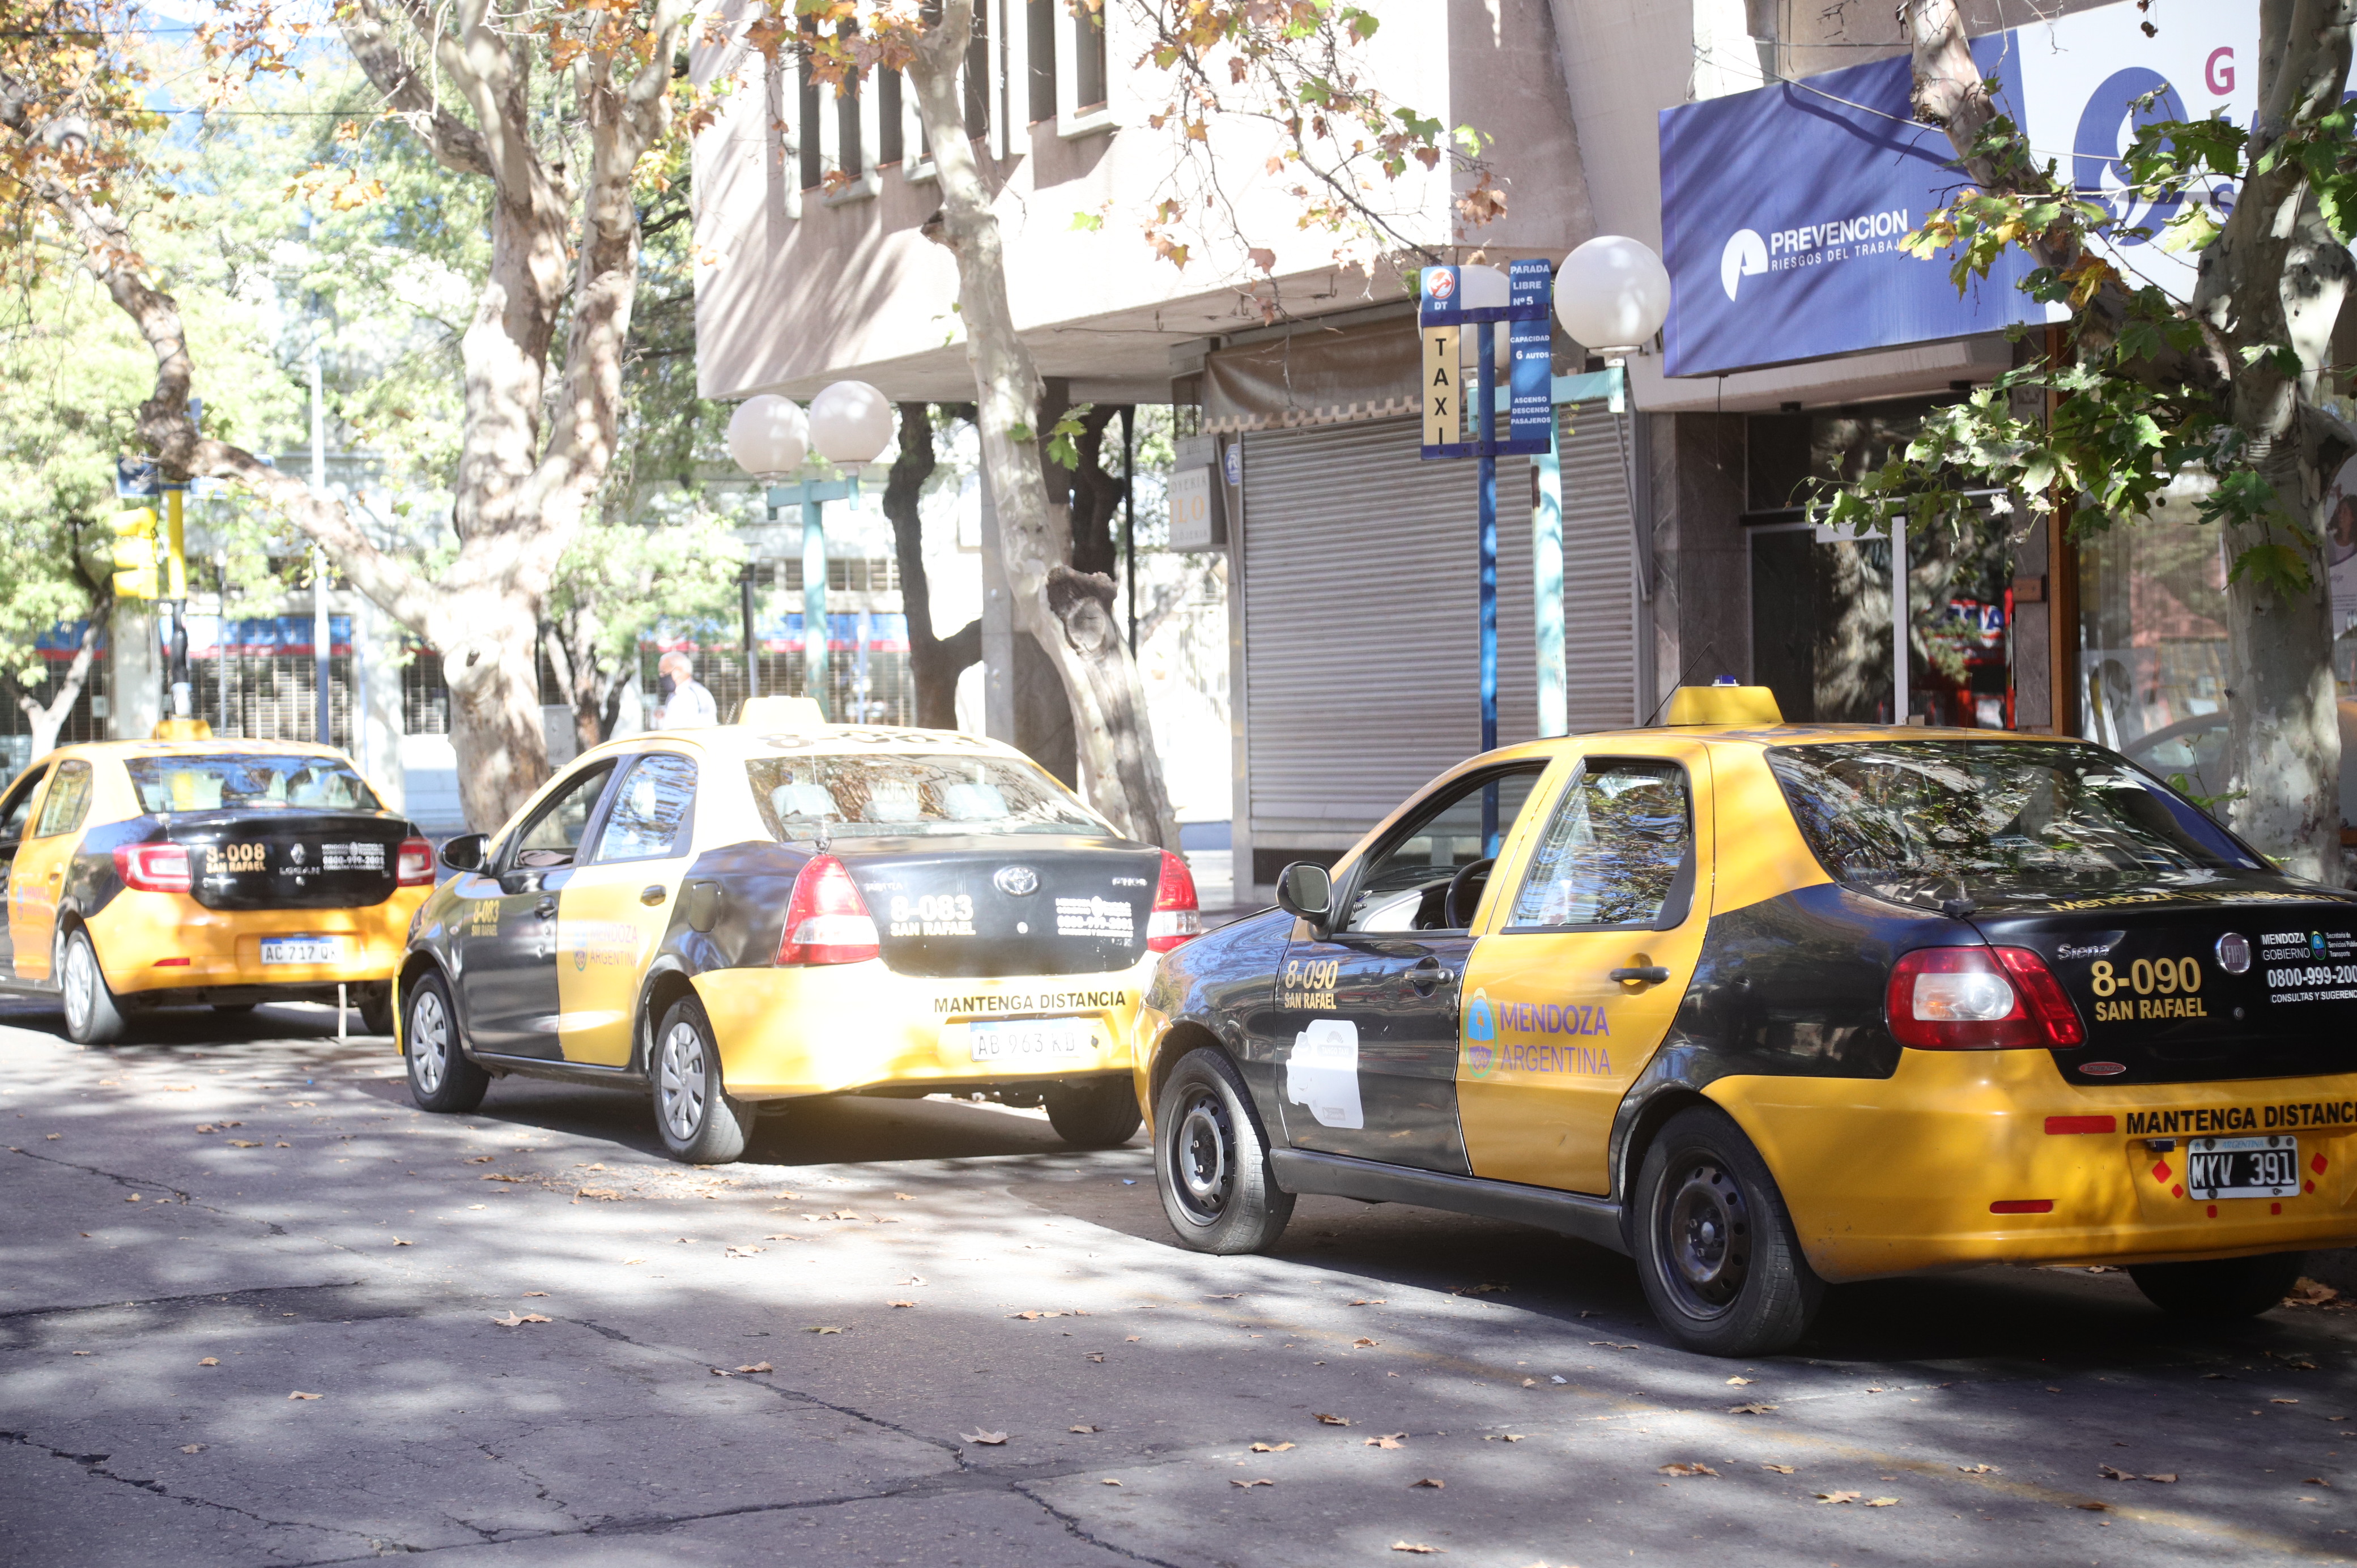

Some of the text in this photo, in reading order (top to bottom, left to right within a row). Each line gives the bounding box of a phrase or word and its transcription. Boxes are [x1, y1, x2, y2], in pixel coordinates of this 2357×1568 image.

[1771, 208, 1908, 255] PREVENCION
[1772, 252, 1822, 271] RIESGOS
[1827, 248, 1849, 262] DEL
[1510, 265, 1550, 274] PARADA
[1513, 281, 1542, 290] LIBRE
[1434, 301, 1448, 310] DT
[1526, 296, 1534, 305] 5
[1510, 335, 1550, 343] CAPACIDAD
[1516, 350, 1523, 360] 6
[1433, 338, 1449, 445] TAXI
[1511, 416, 1551, 425] PASAJEROS
[206, 861, 266, 874] SAN RAFAEL
[322, 855, 385, 864] 0800-999-2001
[473, 900, 500, 923] 8-083
[891, 894, 974, 922] 8-083
[890, 921, 976, 936] SAN RAFAEL
[2261, 932, 2307, 945] MENDOZA
[266, 945, 283, 961] AC
[289, 946, 314, 960] 717
[590, 949, 637, 966] ARGENTINA
[2058, 943, 2110, 960] Siena
[2224, 945, 2245, 963] FIAT
[2263, 948, 2311, 961] GOBIERNO
[1285, 960, 1338, 990] 8-090
[2091, 957, 2201, 997] 8-090
[934, 991, 1126, 1012] MANTENGA DISTANCIA
[1284, 992, 1337, 1009] SAN RAFAEL
[2271, 992, 2313, 1003] CONSULTAS
[2315, 992, 2320, 1000] Y
[2096, 998, 2207, 1021] SAN RAFAEL
[1500, 1002, 1610, 1036] MENDOZA
[978, 1035, 999, 1055] AB
[1009, 1033, 1043, 1053] 963
[1321, 1046, 1350, 1056] TANGO TAXI
[1500, 1045, 1612, 1075] ARGENTINA
[2127, 1108, 2257, 1134] MANTENGA
[2222, 1140, 2265, 1149] ARGENTINA
[2192, 1152, 2295, 1187] MYV 391
